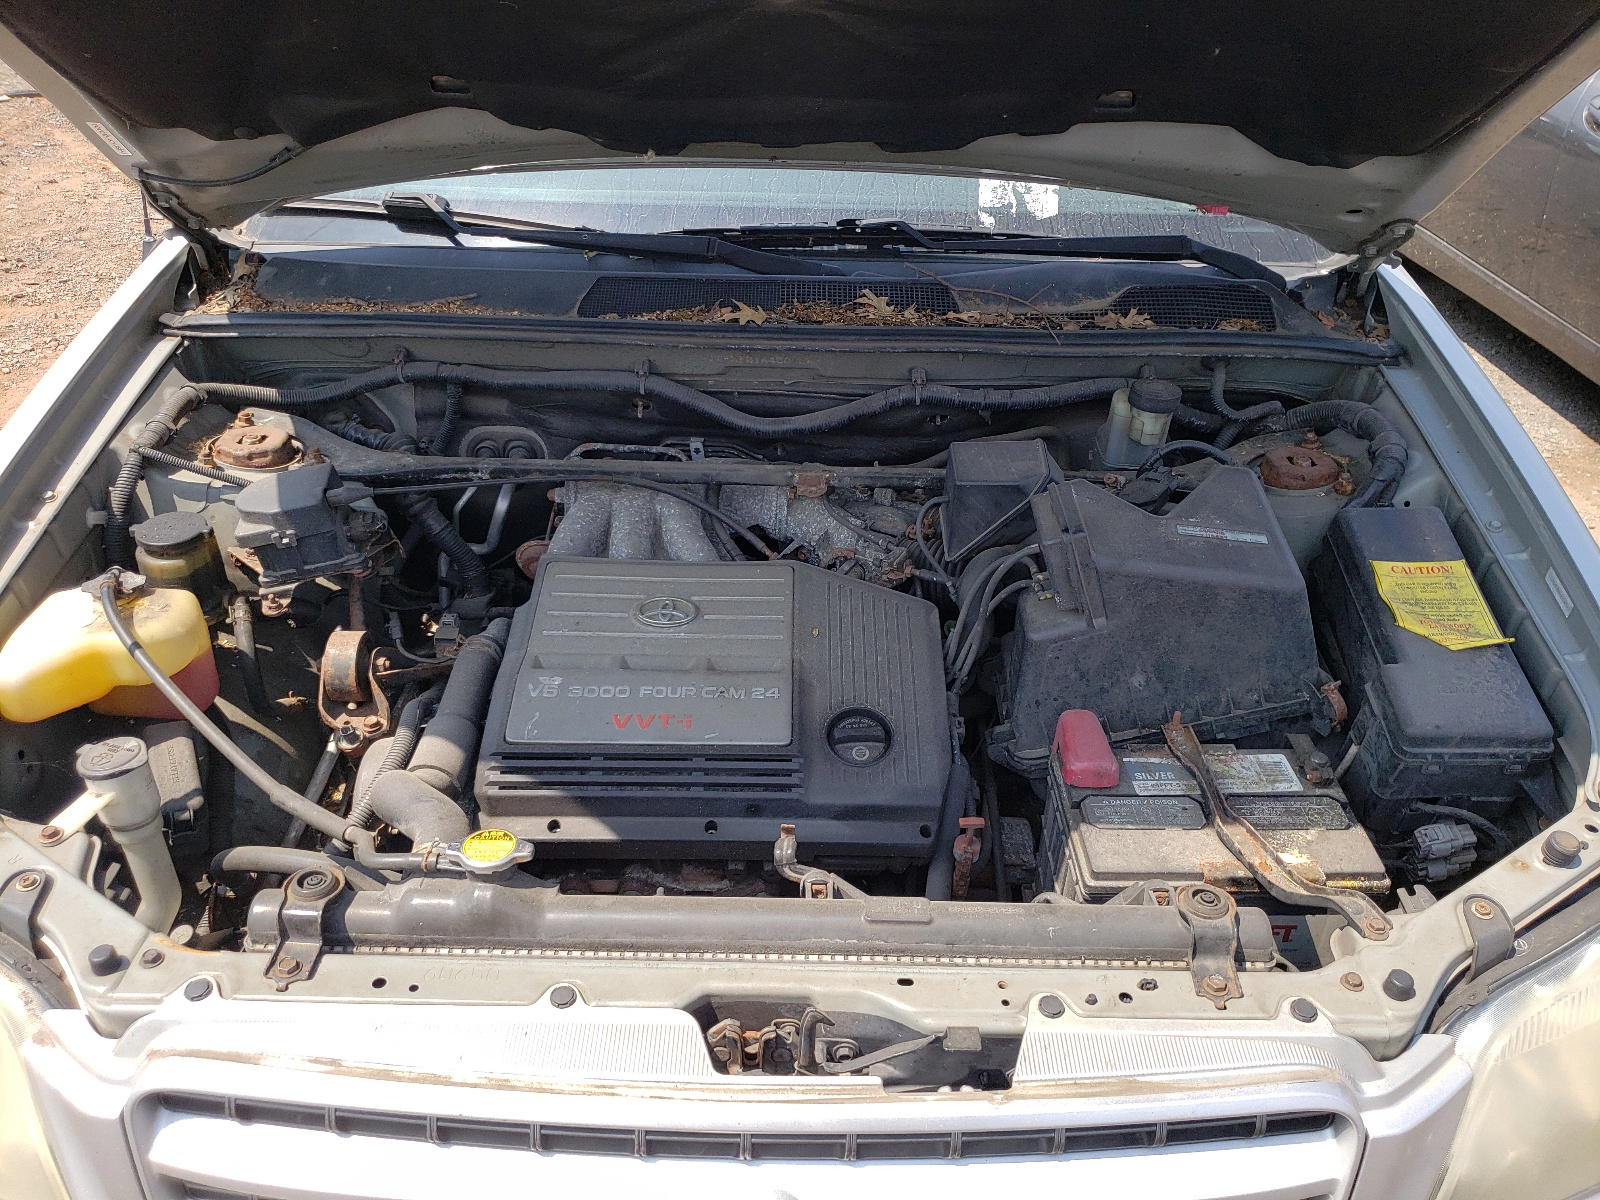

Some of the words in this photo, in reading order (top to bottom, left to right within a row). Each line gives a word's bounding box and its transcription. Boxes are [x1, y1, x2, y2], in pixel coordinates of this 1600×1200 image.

[1391, 565, 1453, 575] CAUTION!
[528, 683, 561, 698] V6
[568, 685, 632, 698] 3000
[639, 685, 697, 698] FOUR
[701, 685, 746, 700] CAM
[751, 686, 781, 700] 24
[612, 712, 693, 730] VVT-i
[1134, 771, 1176, 780] SILVER
